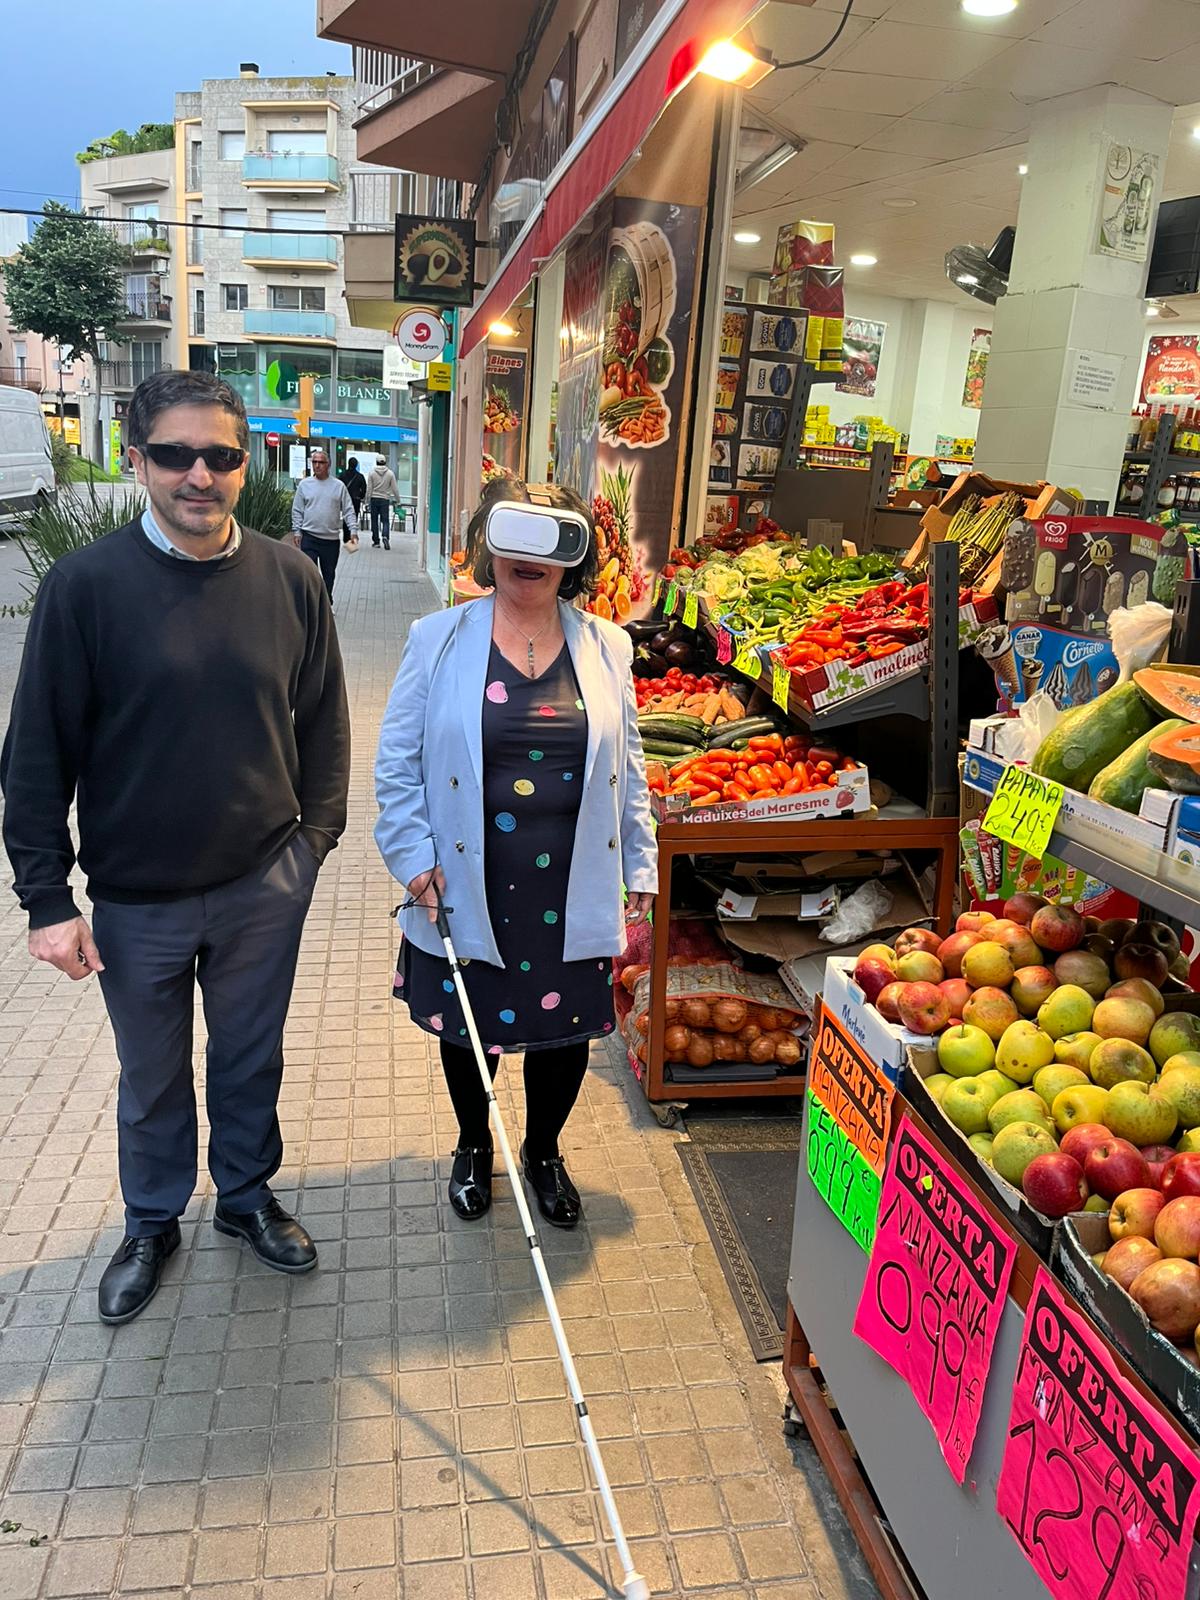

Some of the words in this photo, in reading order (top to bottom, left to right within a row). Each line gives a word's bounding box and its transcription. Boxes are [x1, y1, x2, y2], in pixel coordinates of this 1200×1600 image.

[337, 386, 391, 401] BLANES
[1044, 536, 1064, 544] FRIGO
[1016, 632, 1041, 641] GANAR
[1063, 640, 1104, 668] Cornetto
[1001, 765, 1060, 807] PAPAYA
[682, 808, 748, 824] Maduixes
[749, 807, 765, 817] del
[767, 797, 830, 815] Maresme
[822, 1026, 883, 1129] OFERTA
[900, 1142, 996, 1289] OFERTA
[880, 1191, 988, 1361] MANZANA
[1036, 1305, 1180, 1527] OFERTA
[1015, 1342, 1171, 1563] MANZANA
